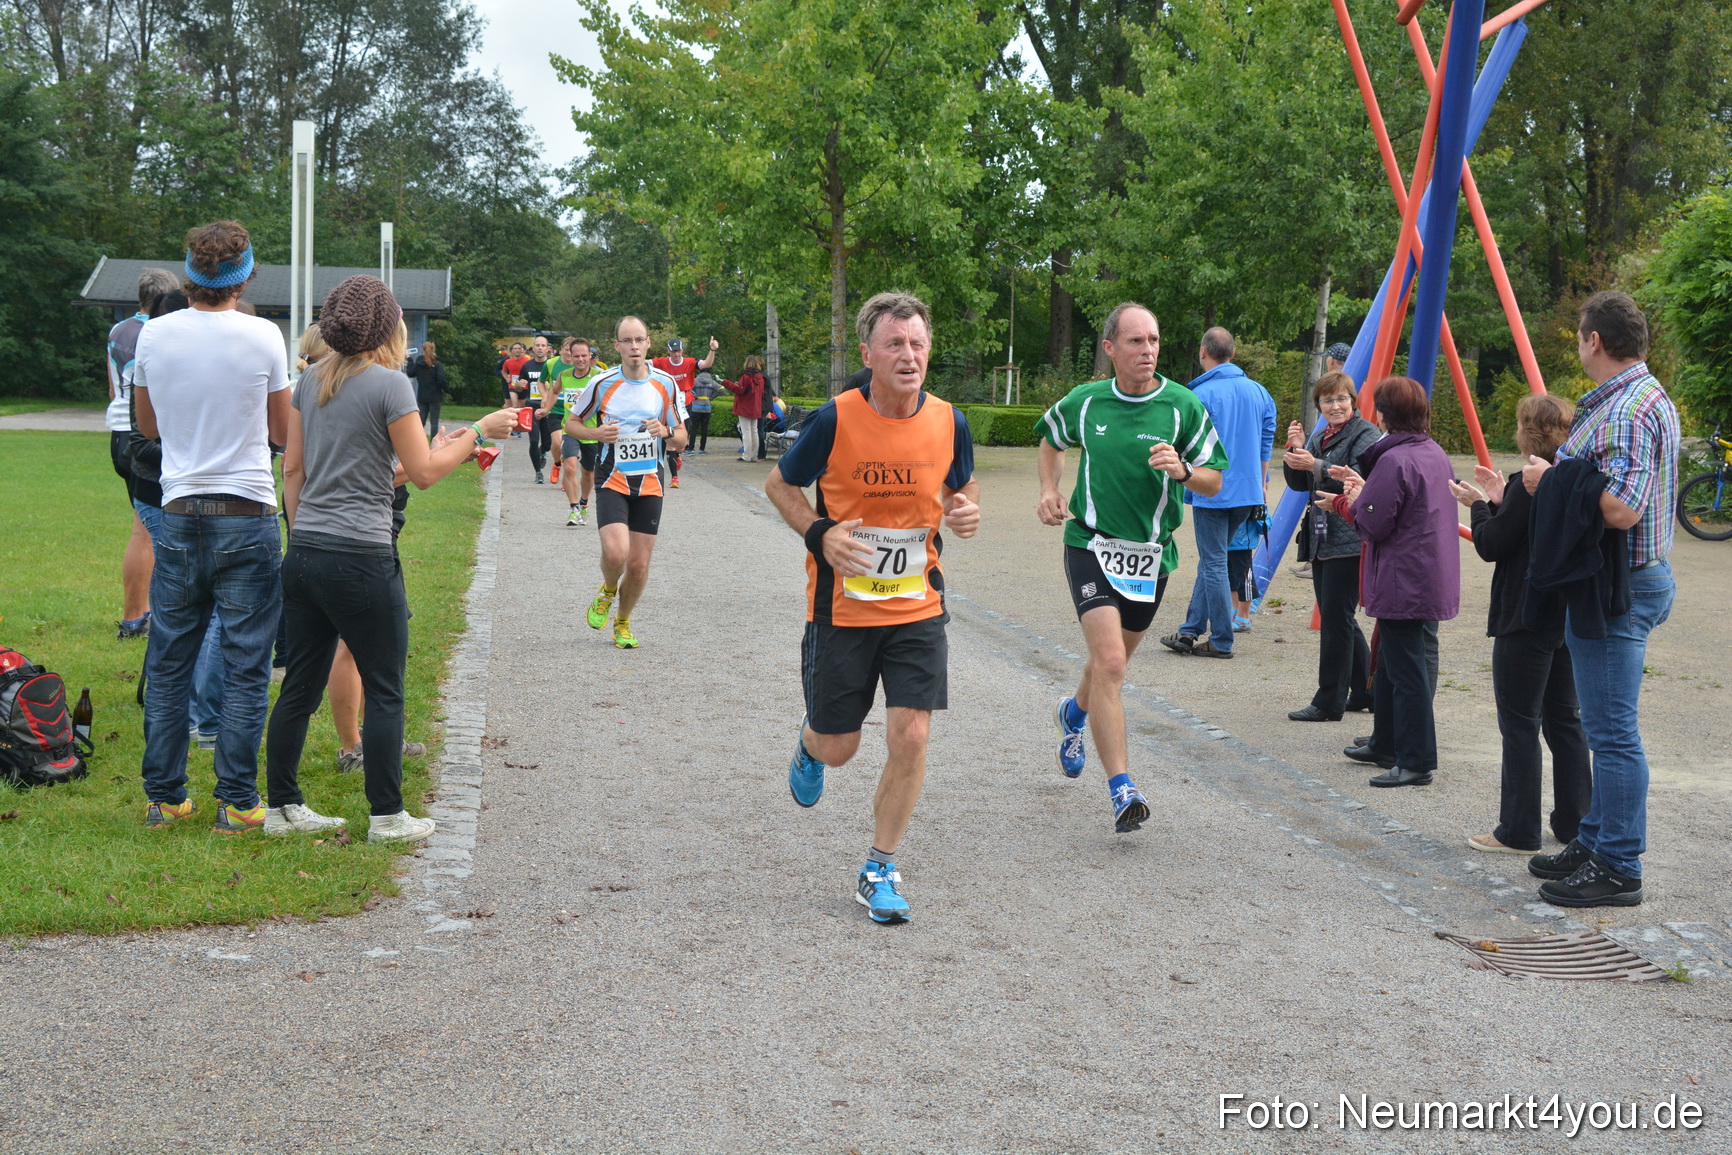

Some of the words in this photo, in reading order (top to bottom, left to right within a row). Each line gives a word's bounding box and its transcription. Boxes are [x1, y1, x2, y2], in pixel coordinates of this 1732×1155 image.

[619, 442, 654, 460] 3341
[863, 469, 917, 486] OEXL
[852, 531, 881, 542] PARTL
[883, 536, 917, 544] Neumarkt
[1095, 540, 1118, 549] PARTL
[1118, 544, 1151, 553] Neumarkt
[876, 546, 907, 575] 70
[1100, 551, 1154, 577] 2392
[871, 581, 900, 593] Xaver
